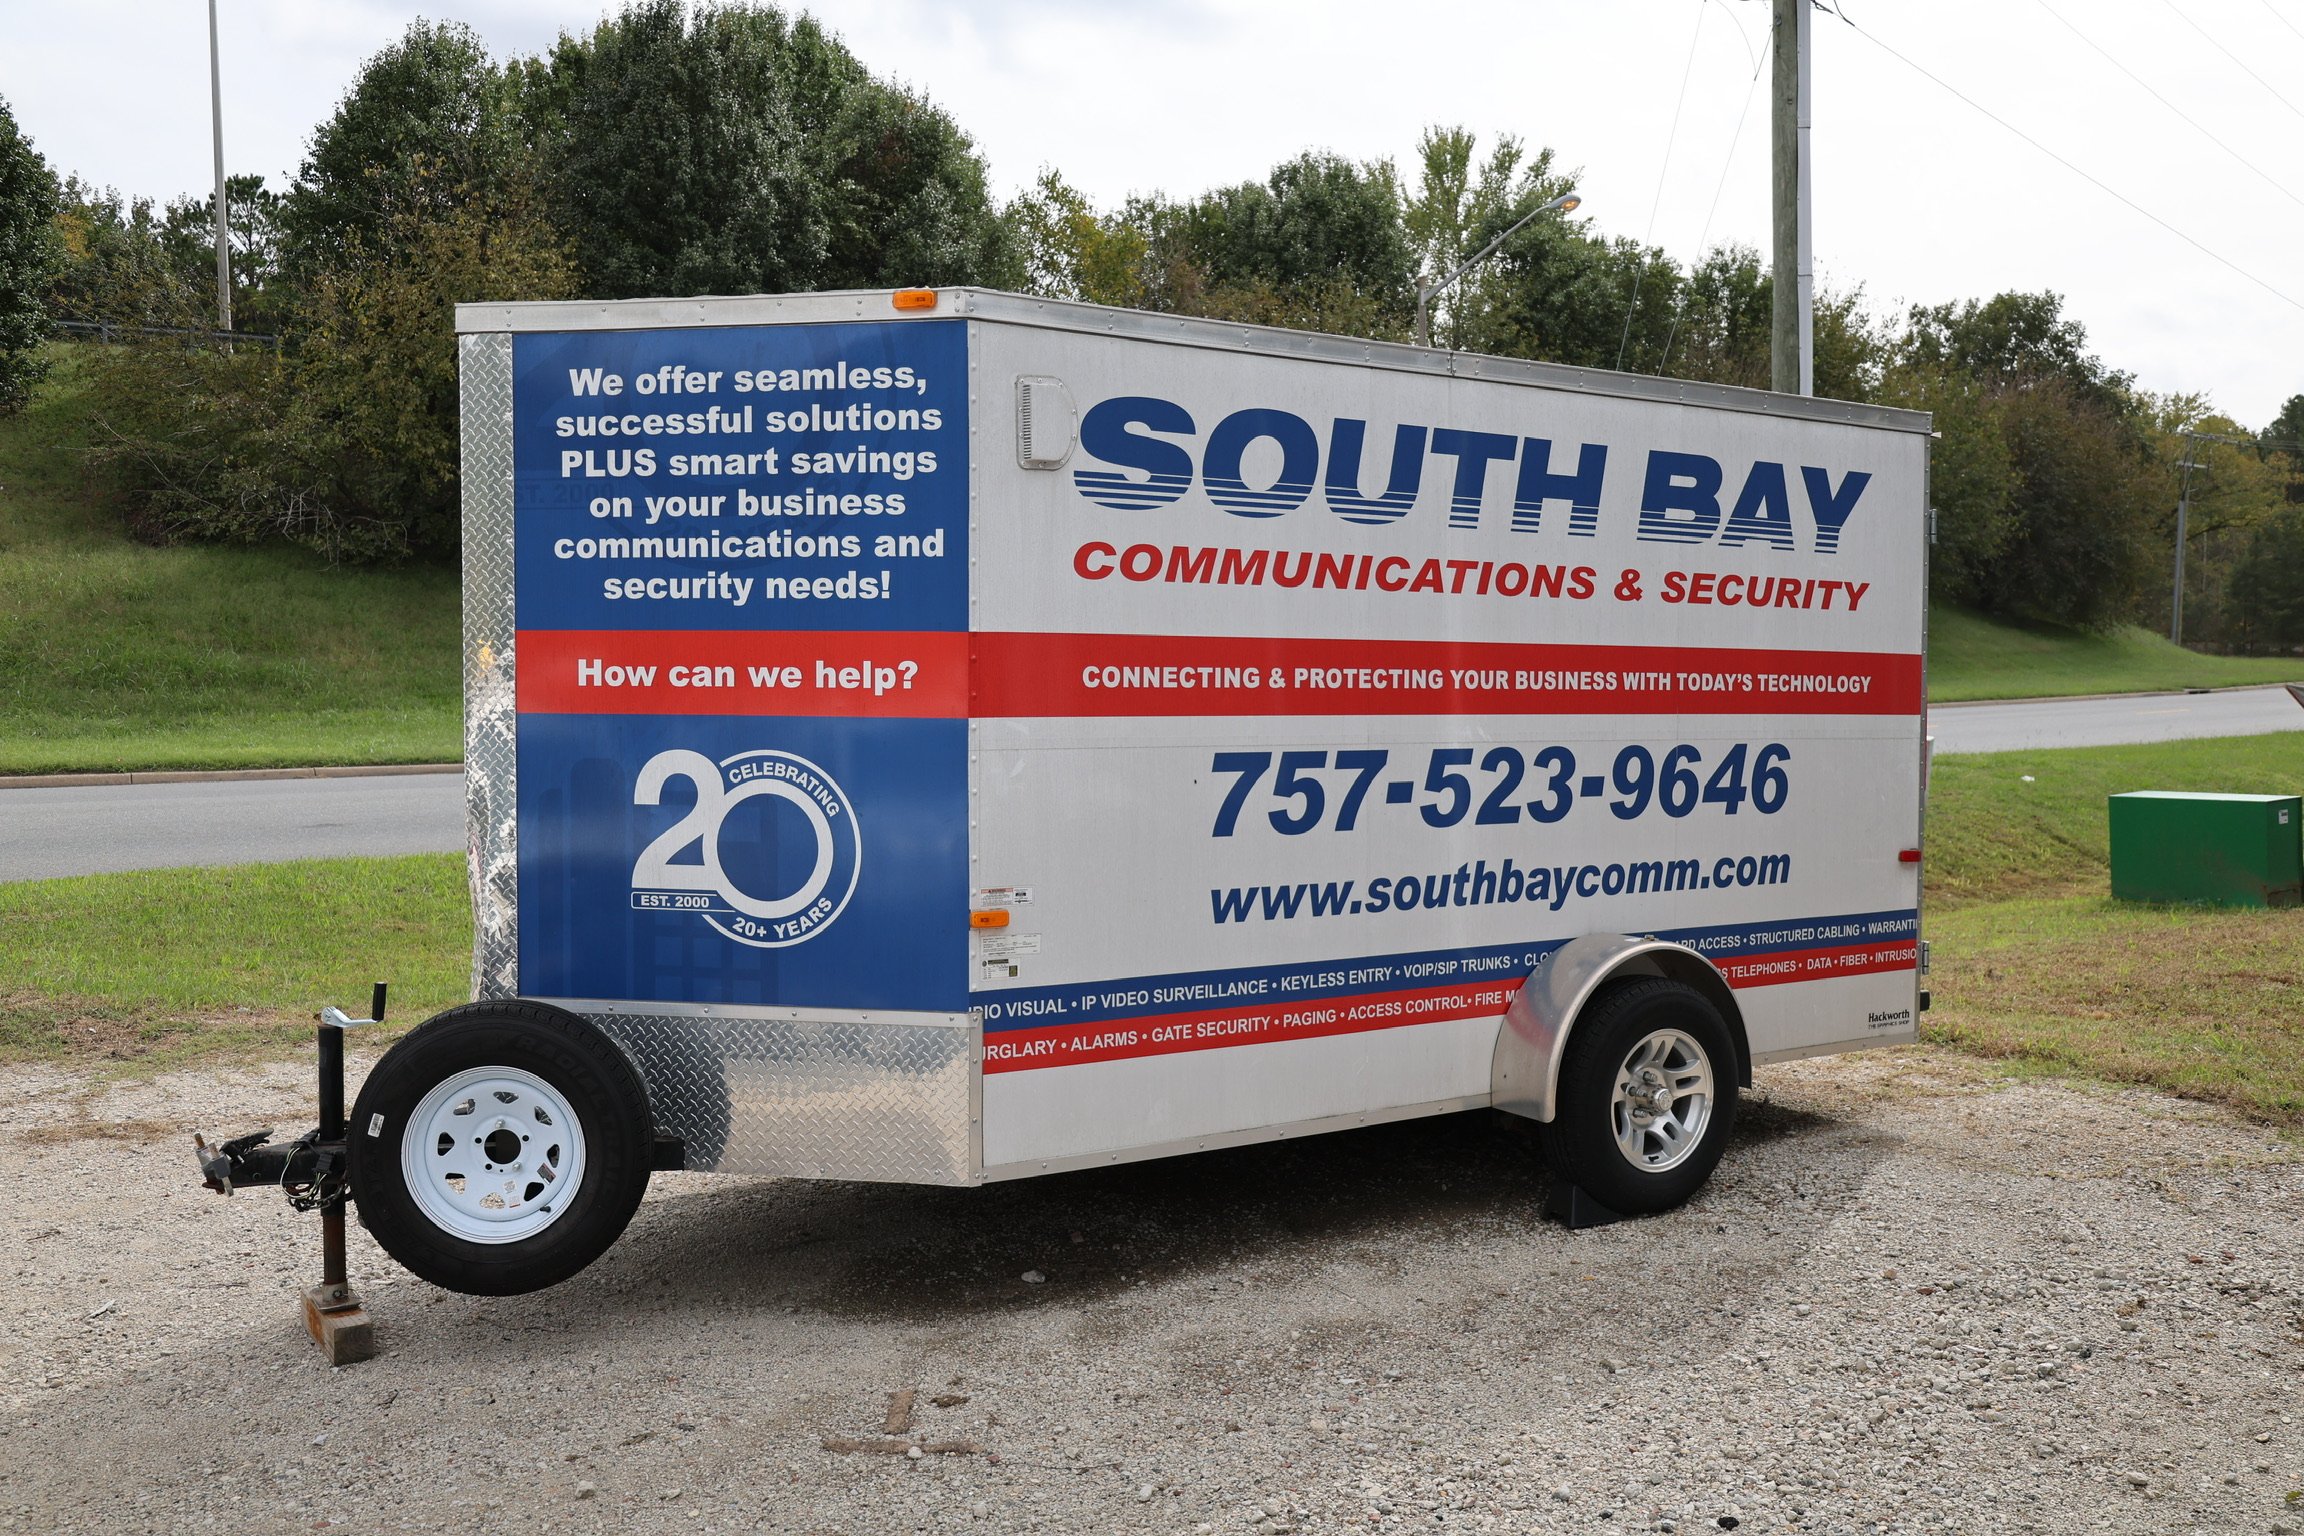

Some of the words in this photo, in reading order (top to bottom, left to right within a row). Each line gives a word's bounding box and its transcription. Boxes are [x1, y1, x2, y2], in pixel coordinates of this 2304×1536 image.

[569, 368, 623, 396] We
[636, 365, 723, 394] offer
[734, 361, 926, 395] seamless,
[556, 406, 752, 437] successful
[766, 403, 942, 432] solutions
[562, 449, 656, 477] PLUS
[669, 447, 778, 475] smart
[791, 445, 937, 480] savings
[1074, 396, 1609, 537] SOUTH
[1637, 450, 1872, 554] BAY
[590, 497, 632, 518] on
[645, 496, 726, 524] your
[739, 488, 905, 516] business
[554, 529, 861, 559] communications
[874, 529, 943, 557] and
[604, 571, 754, 606] security
[767, 571, 890, 599] needs!
[1074, 542, 1596, 599] COMMUNICATIONS
[1615, 569, 1642, 600] &
[1662, 572, 1868, 610] SECURITY
[578, 659, 657, 686] How
[669, 666, 734, 687] can
[748, 667, 802, 688] we
[816, 660, 918, 696] help?
[1083, 666, 1259, 688] CONNECTING
[1269, 668, 1285, 688] &
[1295, 668, 1443, 689] PROTECTING
[1450, 670, 1508, 689] YOUR
[1516, 671, 1617, 690] BUSINESS
[1623, 672, 1670, 690] WITH
[1758, 674, 1871, 692] TECHNOLOGY
[728, 761, 840, 818] CELEBRATING
[1212, 744, 1791, 837] 757-523-9646
[640, 896, 670, 907] EST.
[674, 896, 710, 909] 2000
[1211, 854, 1790, 924] www.southbaycomm.com
[772, 896, 834, 940] YEARS
[1006, 999, 1067, 1016] VISUAL
[1082, 996, 1096, 1010] IP
[1101, 991, 1148, 1008] VIDEO
[1154, 980, 1267, 1003] SURVEILLANCE
[1282, 972, 1344, 991] KEYLESS
[1350, 967, 1392, 984] ENTRY
[1404, 961, 1457, 977] VOIP/SIP
[1461, 956, 1510, 972] TRUNKS
[1524, 951, 1552, 967] CLO
[1698, 936, 1741, 950] ACCESS
[1750, 928, 1814, 945] STRUCTURED
[1818, 924, 1859, 938] CABLING
[1869, 918, 1917, 935] WARRANTI
[982, 1039, 1057, 1061] RGLARY
[1071, 1031, 1137, 1051] ALARMS
[1152, 1024, 1192, 1042] GATE
[1197, 1016, 1270, 1037] SECURITY
[1284, 1010, 1336, 1027] PAGING
[1348, 1002, 1401, 1020] ACCESS
[1406, 996, 1466, 1013] CONTROL
[1476, 992, 1501, 1006] FIRE
[1731, 961, 1796, 977] TELEPHONES
[1808, 957, 1831, 969] DATA
[1841, 954, 1867, 966] FIBER
[1868, 1009, 1910, 1023] Hackworth
